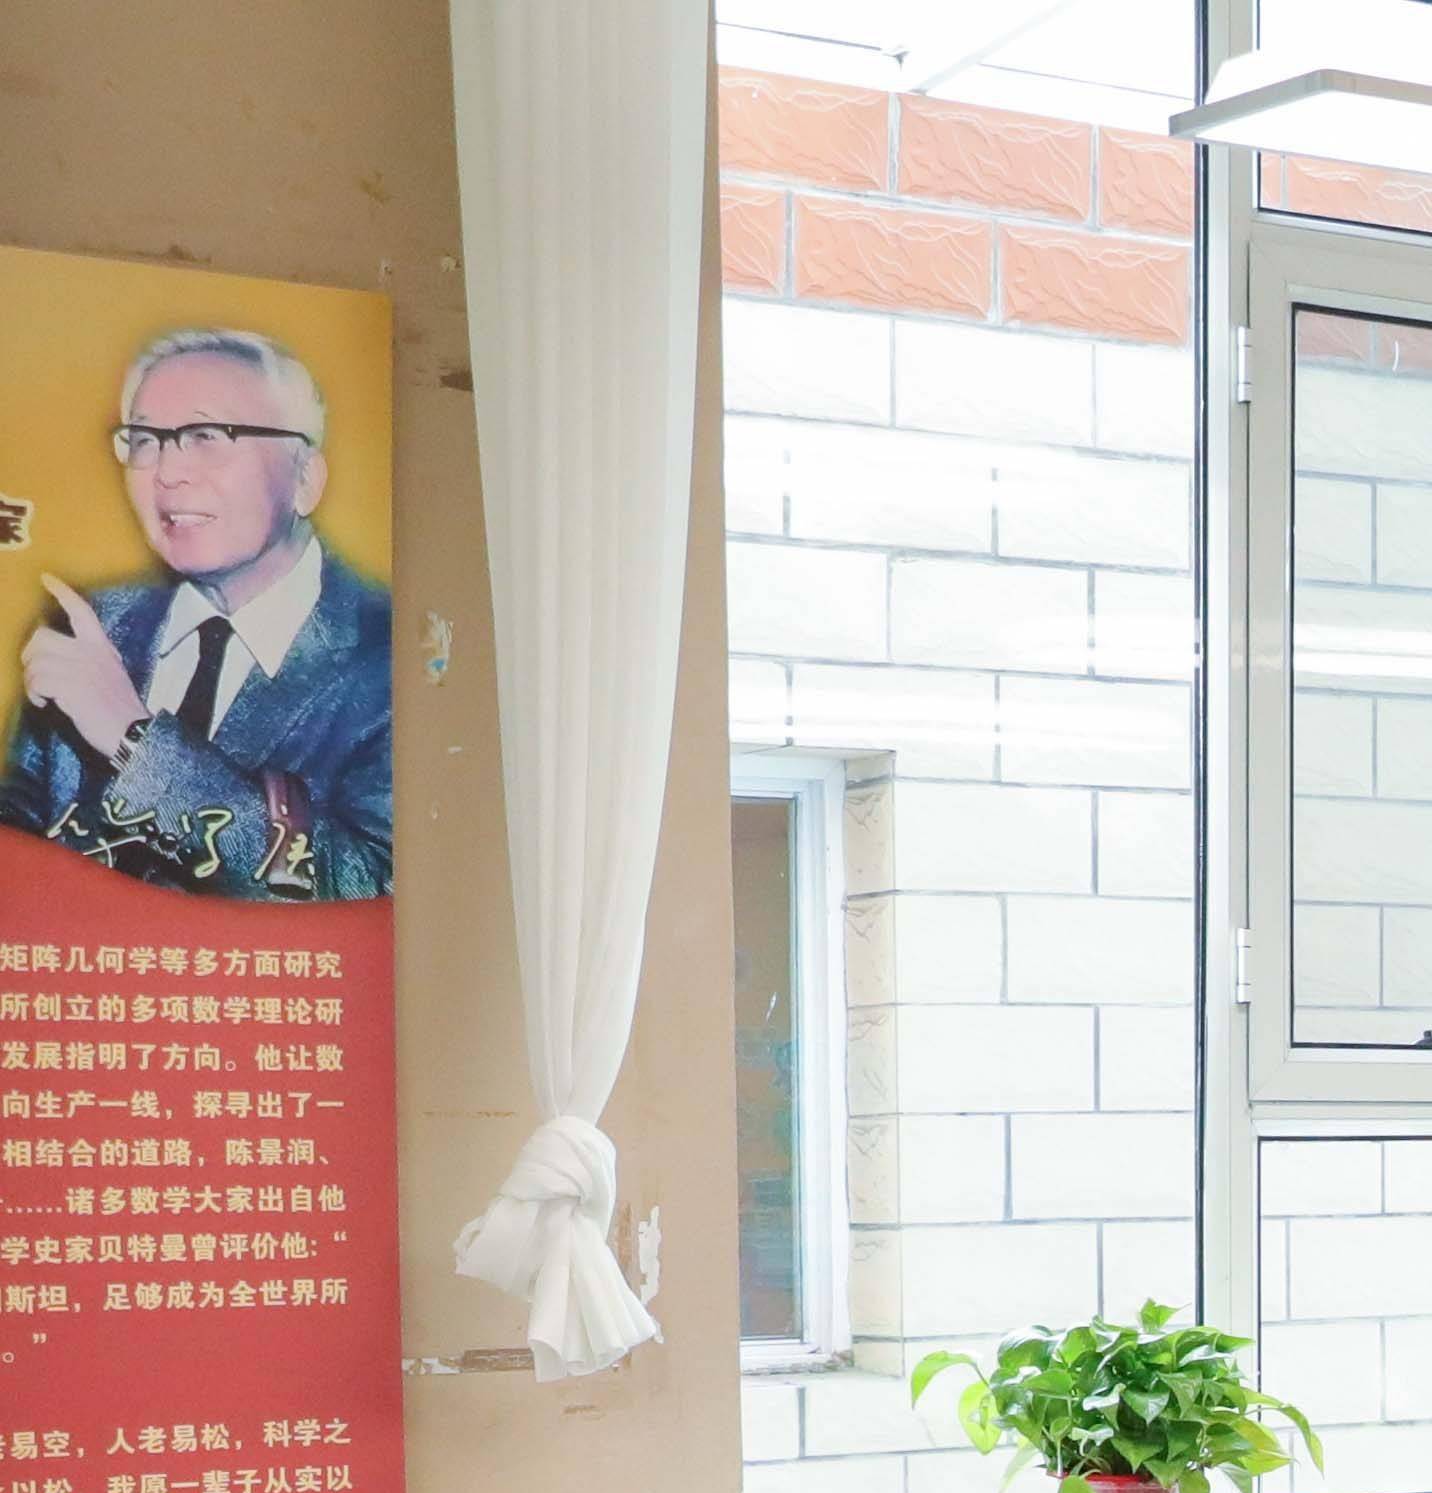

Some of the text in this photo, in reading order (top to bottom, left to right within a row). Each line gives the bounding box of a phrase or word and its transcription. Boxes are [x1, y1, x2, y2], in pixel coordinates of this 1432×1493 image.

[0, 943, 343, 979] 矩阵几何学等多方面研究
[0, 992, 343, 1027] 所创立的多项数学理论研
[1, 1041, 345, 1073] 发展指明了方向。他让数
[3, 1089, 345, 1120] 向生产一线，探寻出了一
[4, 1138, 331, 1168] 相结合的道路，陈景润、
[0, 1277, 348, 1314] 斯坦，足够成为全世界所
[0, 1418, 352, 1460] 易空，人老易松，科学之
